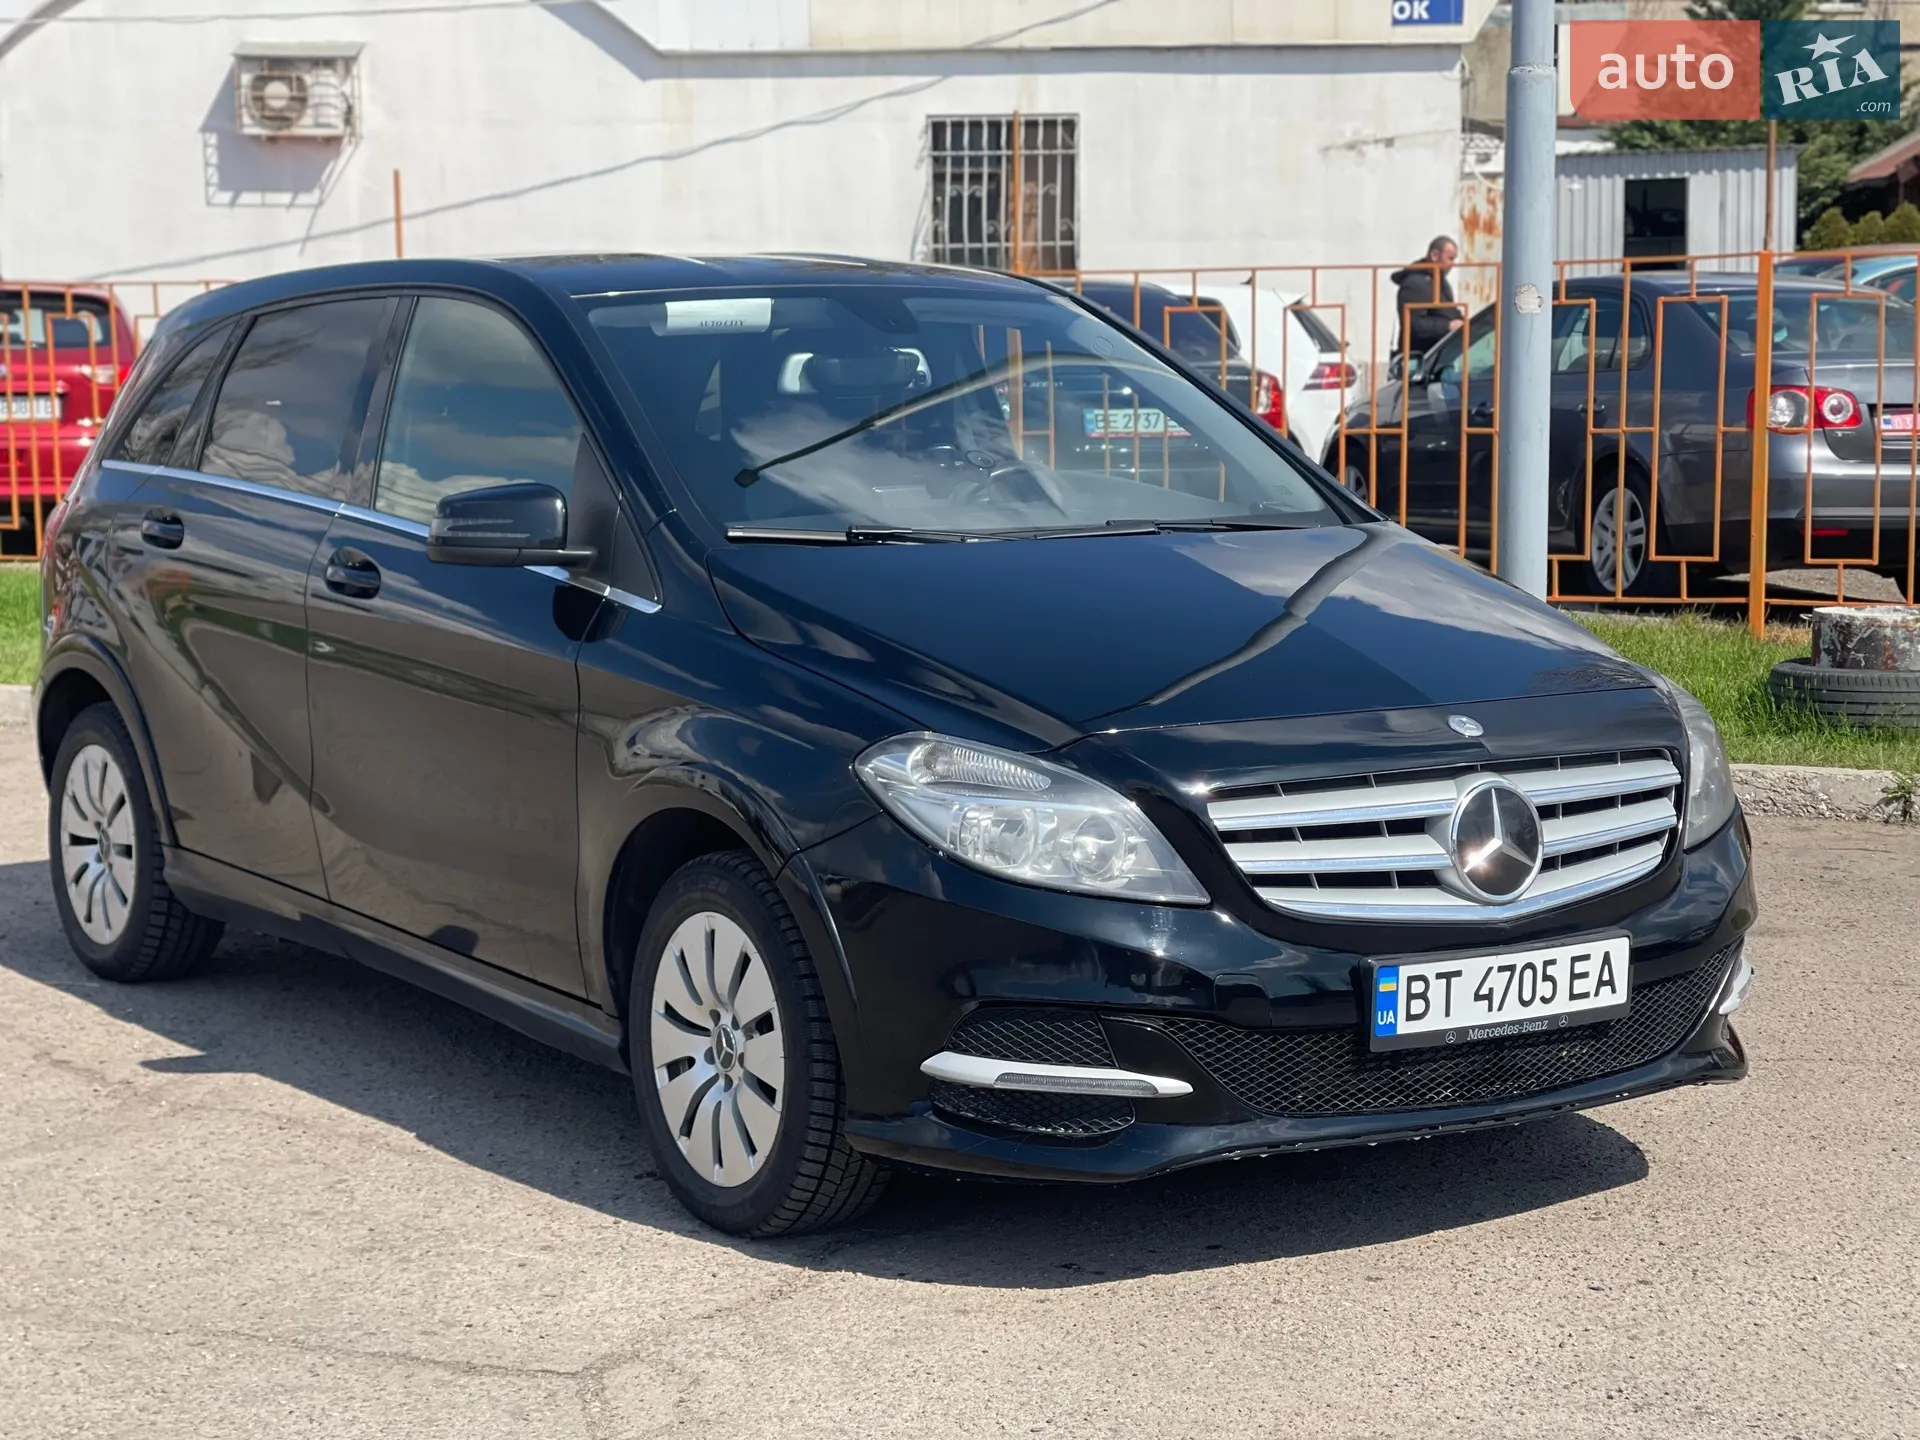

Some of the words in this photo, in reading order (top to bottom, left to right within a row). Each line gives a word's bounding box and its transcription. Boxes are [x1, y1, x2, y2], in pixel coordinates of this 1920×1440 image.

[699, 320, 723, 328] AUTO
[724, 319, 745, 327] CITY
[1405, 969, 1463, 1022] BT
[1473, 958, 1558, 1013] 4705
[1569, 950, 1617, 1002] EA
[1377, 1010, 1396, 1025] UA
[1466, 1019, 1549, 1041] Mercedes-Benz
